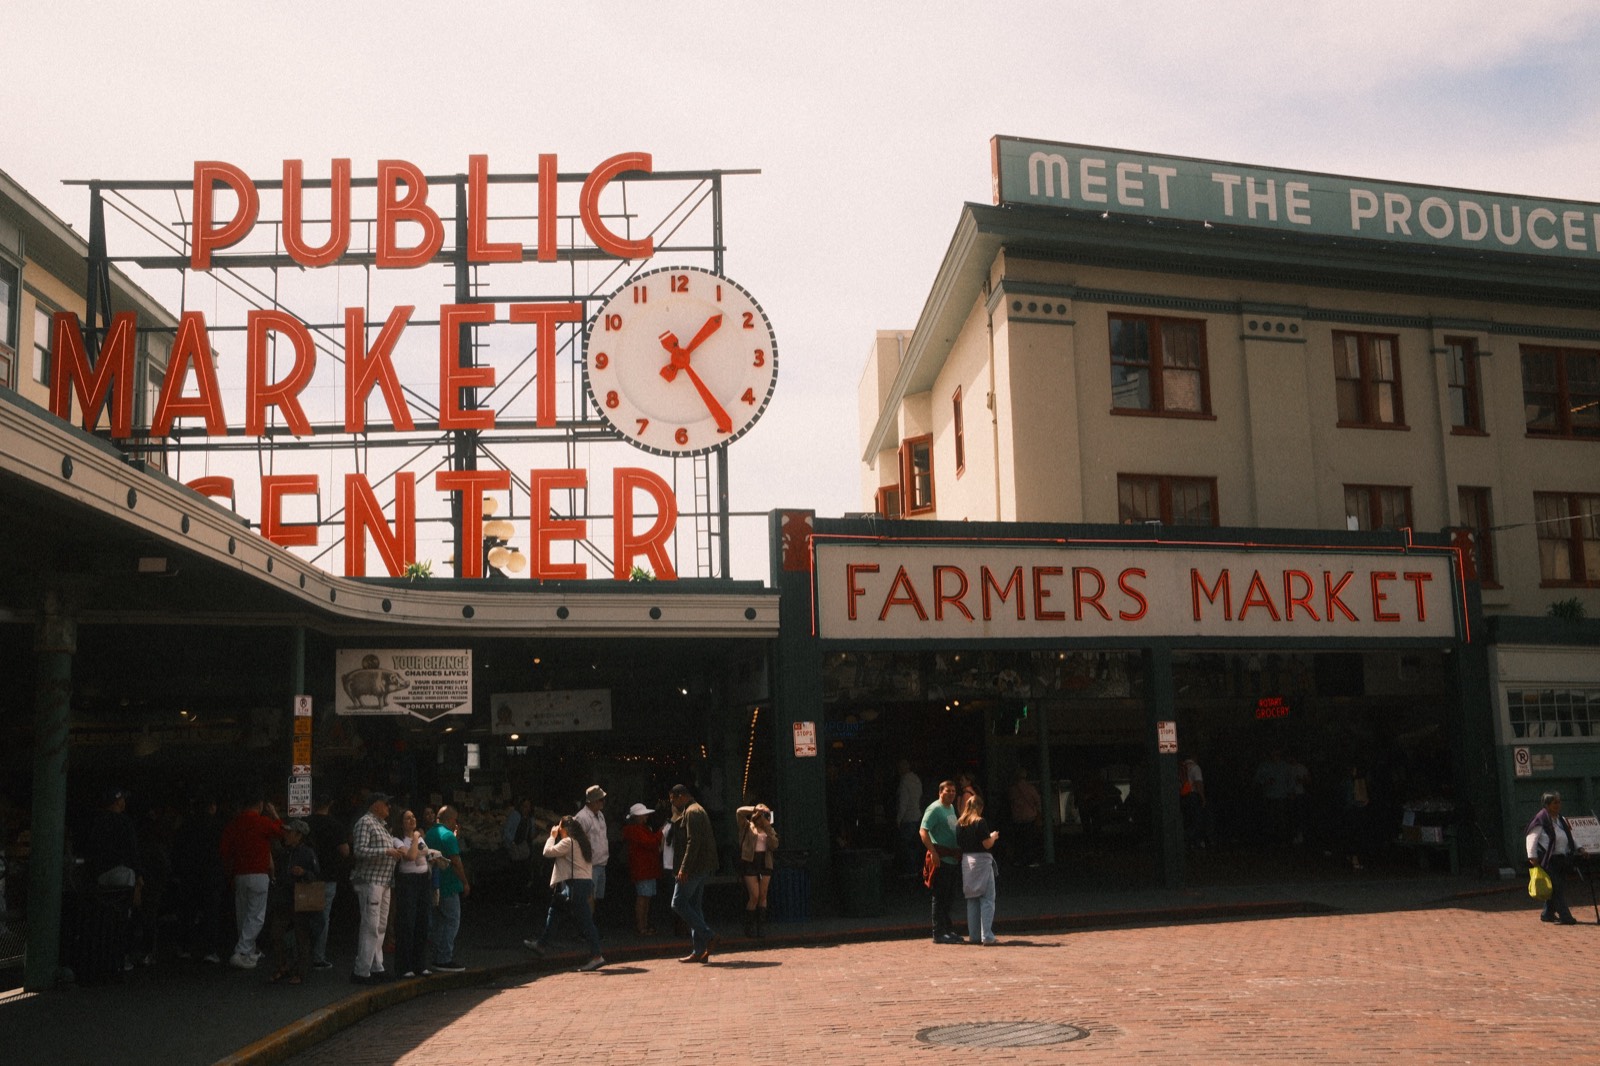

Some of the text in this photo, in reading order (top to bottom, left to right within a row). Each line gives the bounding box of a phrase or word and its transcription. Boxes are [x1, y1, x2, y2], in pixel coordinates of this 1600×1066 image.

[1028, 151, 1600, 252] MEET THE PRODUCE
[191, 151, 655, 271] PUBLIC
[670, 275, 689, 293] 12
[633, 286, 647, 304] 11
[716, 285, 722, 302] 1
[605, 314, 623, 331] 10
[742, 312, 754, 329] 2
[595, 352, 609, 370] 9
[753, 349, 765, 368] 3
[48, 302, 585, 439] MARKET
[606, 390, 620, 409] 8
[741, 387, 756, 406] 4
[636, 418, 650, 436] 7
[675, 428, 688, 446] 6
[187, 466, 679, 582] ENTER
[846, 563, 1433, 623] FARMERS MARKET
[391, 655, 469, 670] YOUR CHANGE
[1255, 706, 1289, 719] GROCERY
[1570, 818, 1599, 827] PARKING
